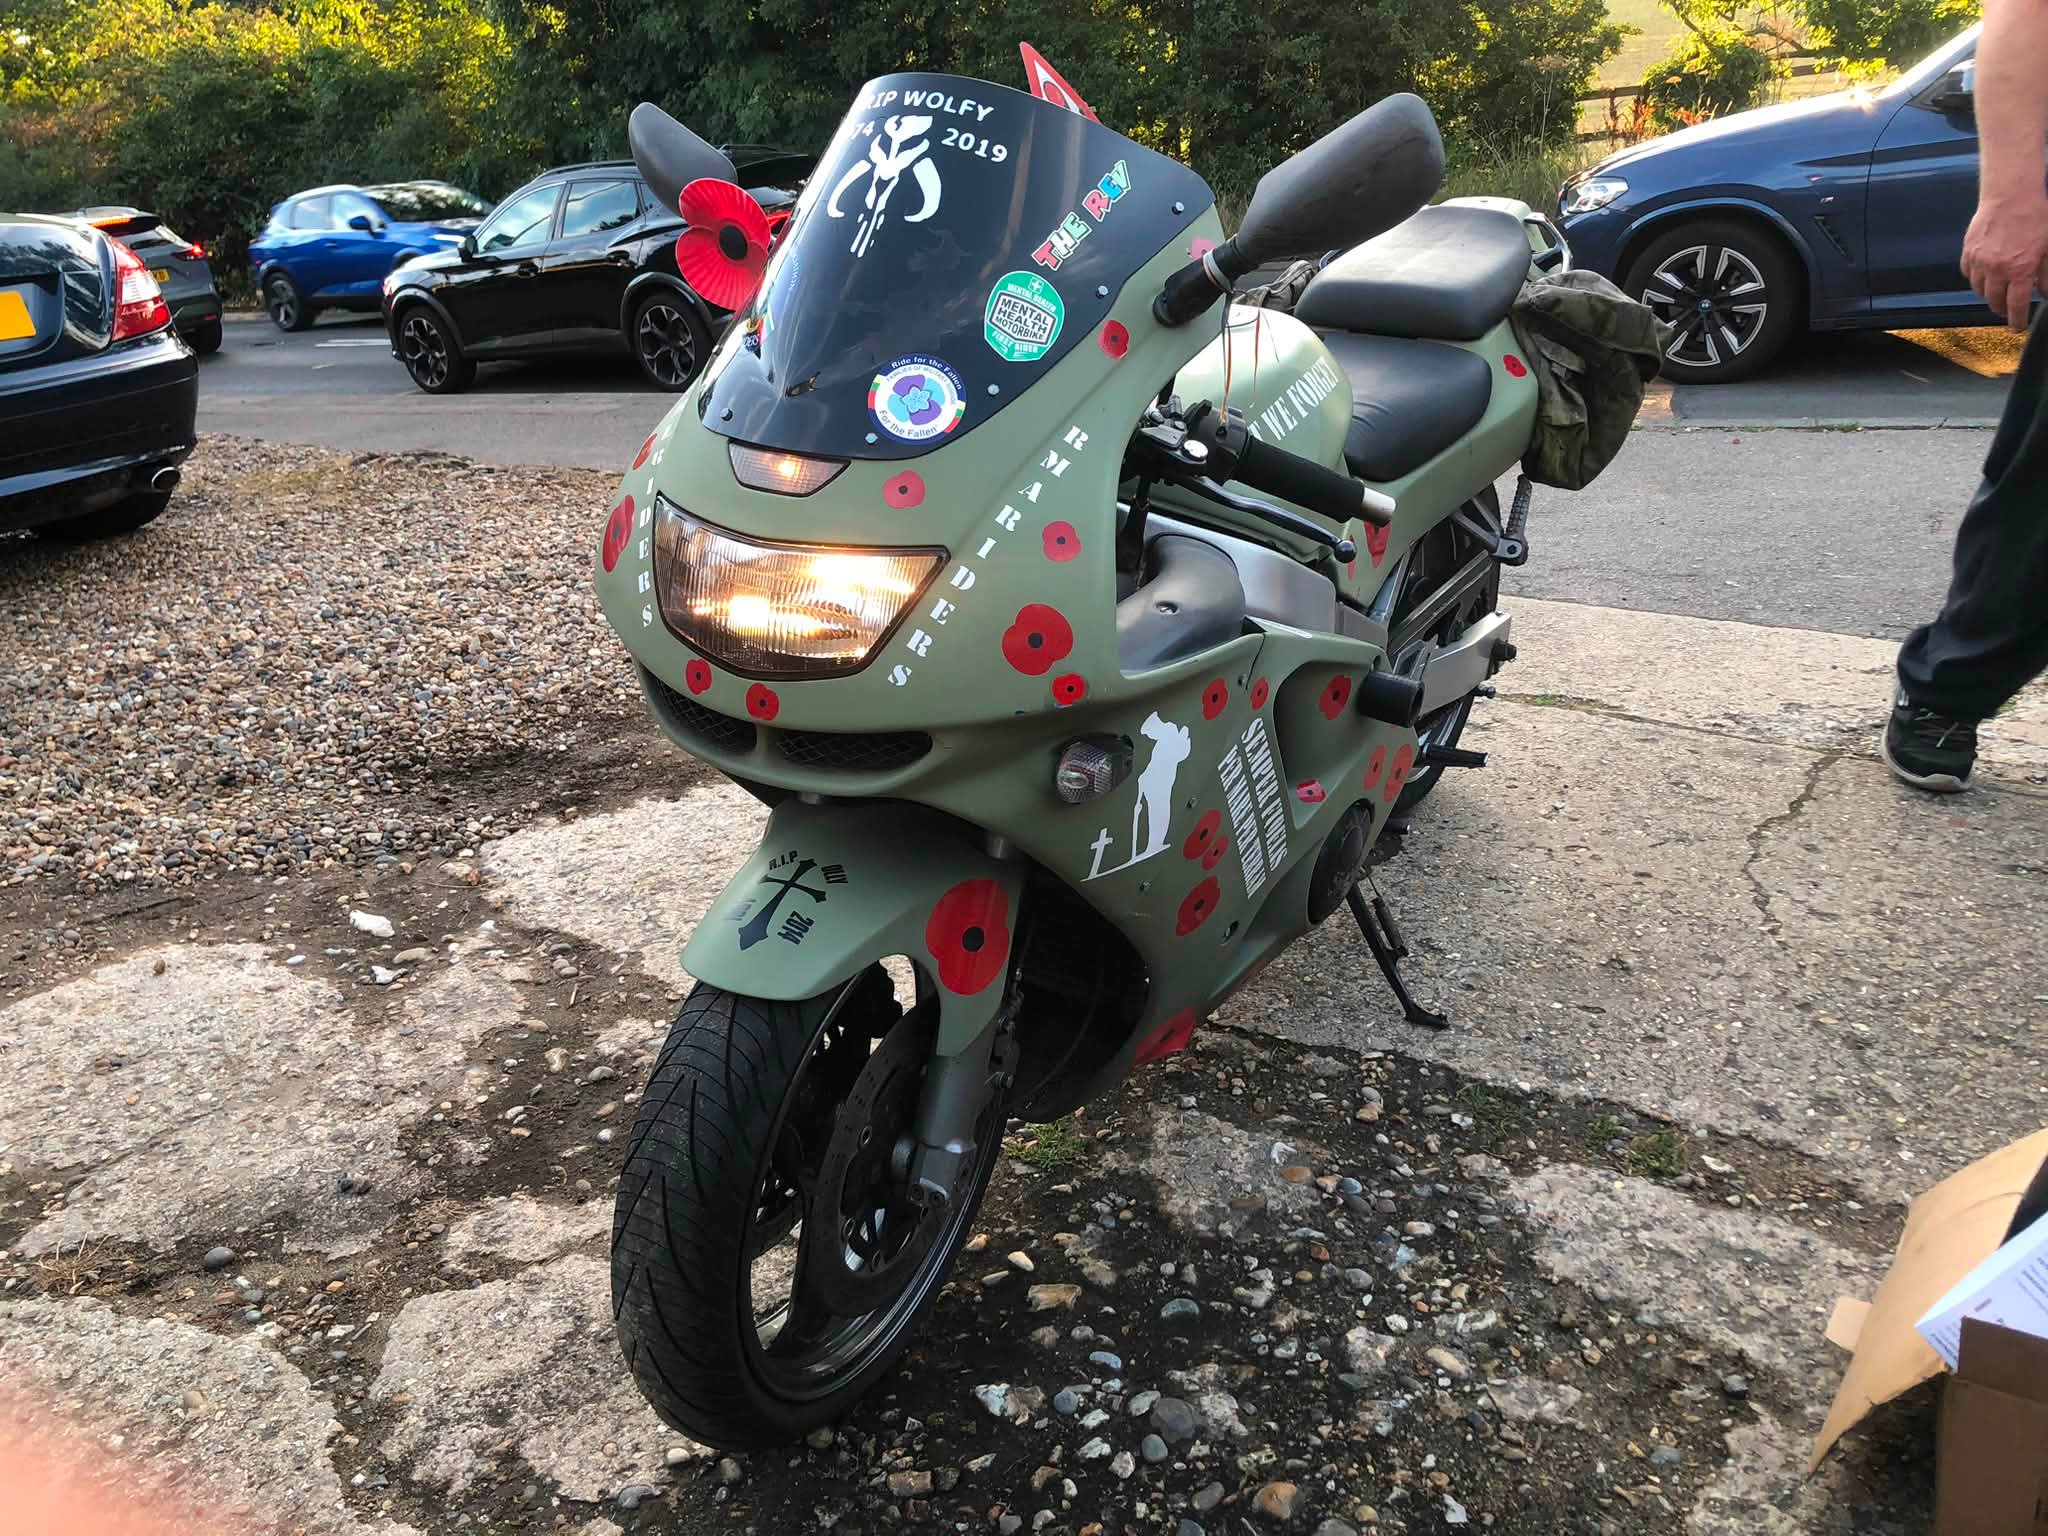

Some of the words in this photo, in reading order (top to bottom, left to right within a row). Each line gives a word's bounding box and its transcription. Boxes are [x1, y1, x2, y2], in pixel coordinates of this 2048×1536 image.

[903, 90, 994, 121] WOLFY
[941, 128, 1008, 162] 2019
[1031, 211, 1092, 271] THE
[1081, 160, 1131, 222] REV
[995, 315, 1045, 340] MOTORBIKE
[998, 308, 1048, 334] HEALTH
[1001, 298, 1049, 326] MENTAL
[891, 359, 911, 369] Ride
[929, 359, 943, 369] the
[943, 365, 962, 390] Fallen
[1261, 396, 1298, 441] WE
[1286, 356, 1339, 418] FORGET
[879, 410, 891, 424] For
[890, 423, 905, 435] the
[907, 426, 938, 438] Fallen
[1217, 744, 1243, 792] PER
[1227, 774, 1253, 829] MARE
[1241, 717, 1279, 809] SEMPER
[1261, 797, 1288, 872] FIDELIS
[1236, 812, 1259, 854] PER
[777, 910, 815, 945] 2014
